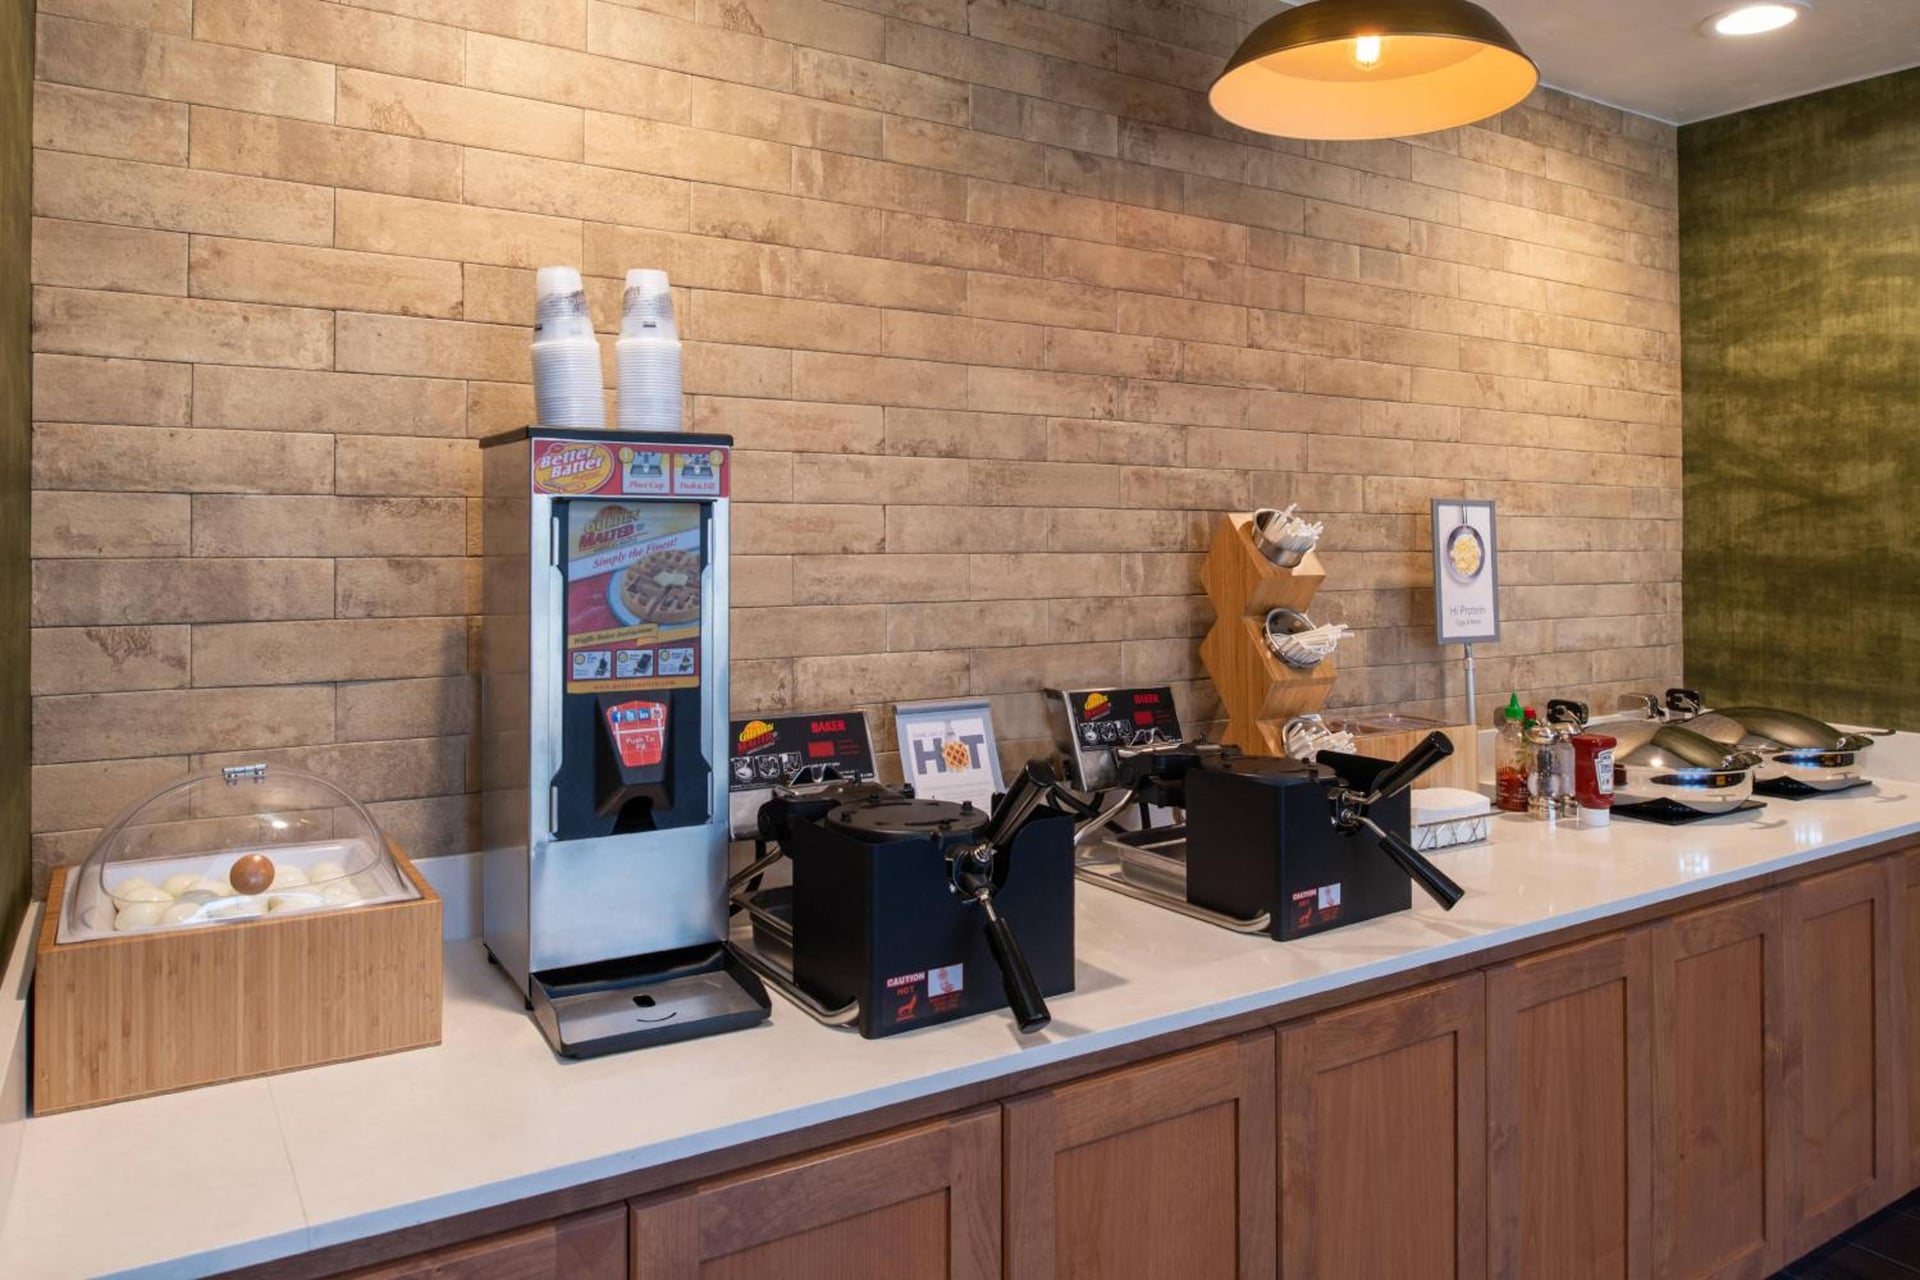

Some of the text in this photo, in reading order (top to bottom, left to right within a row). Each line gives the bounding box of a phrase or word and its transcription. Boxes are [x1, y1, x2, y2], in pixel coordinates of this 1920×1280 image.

[540, 447, 594, 469] Better
[550, 458, 605, 479] Batter
[579, 524, 635, 552] MALTED
[593, 550, 627, 569] Simply
[629, 547, 643, 559] the
[1460, 605, 1486, 616] Protein
[810, 720, 846, 734] BAKER
[886, 971, 926, 988] CAUTION
[896, 985, 915, 997] HOT
